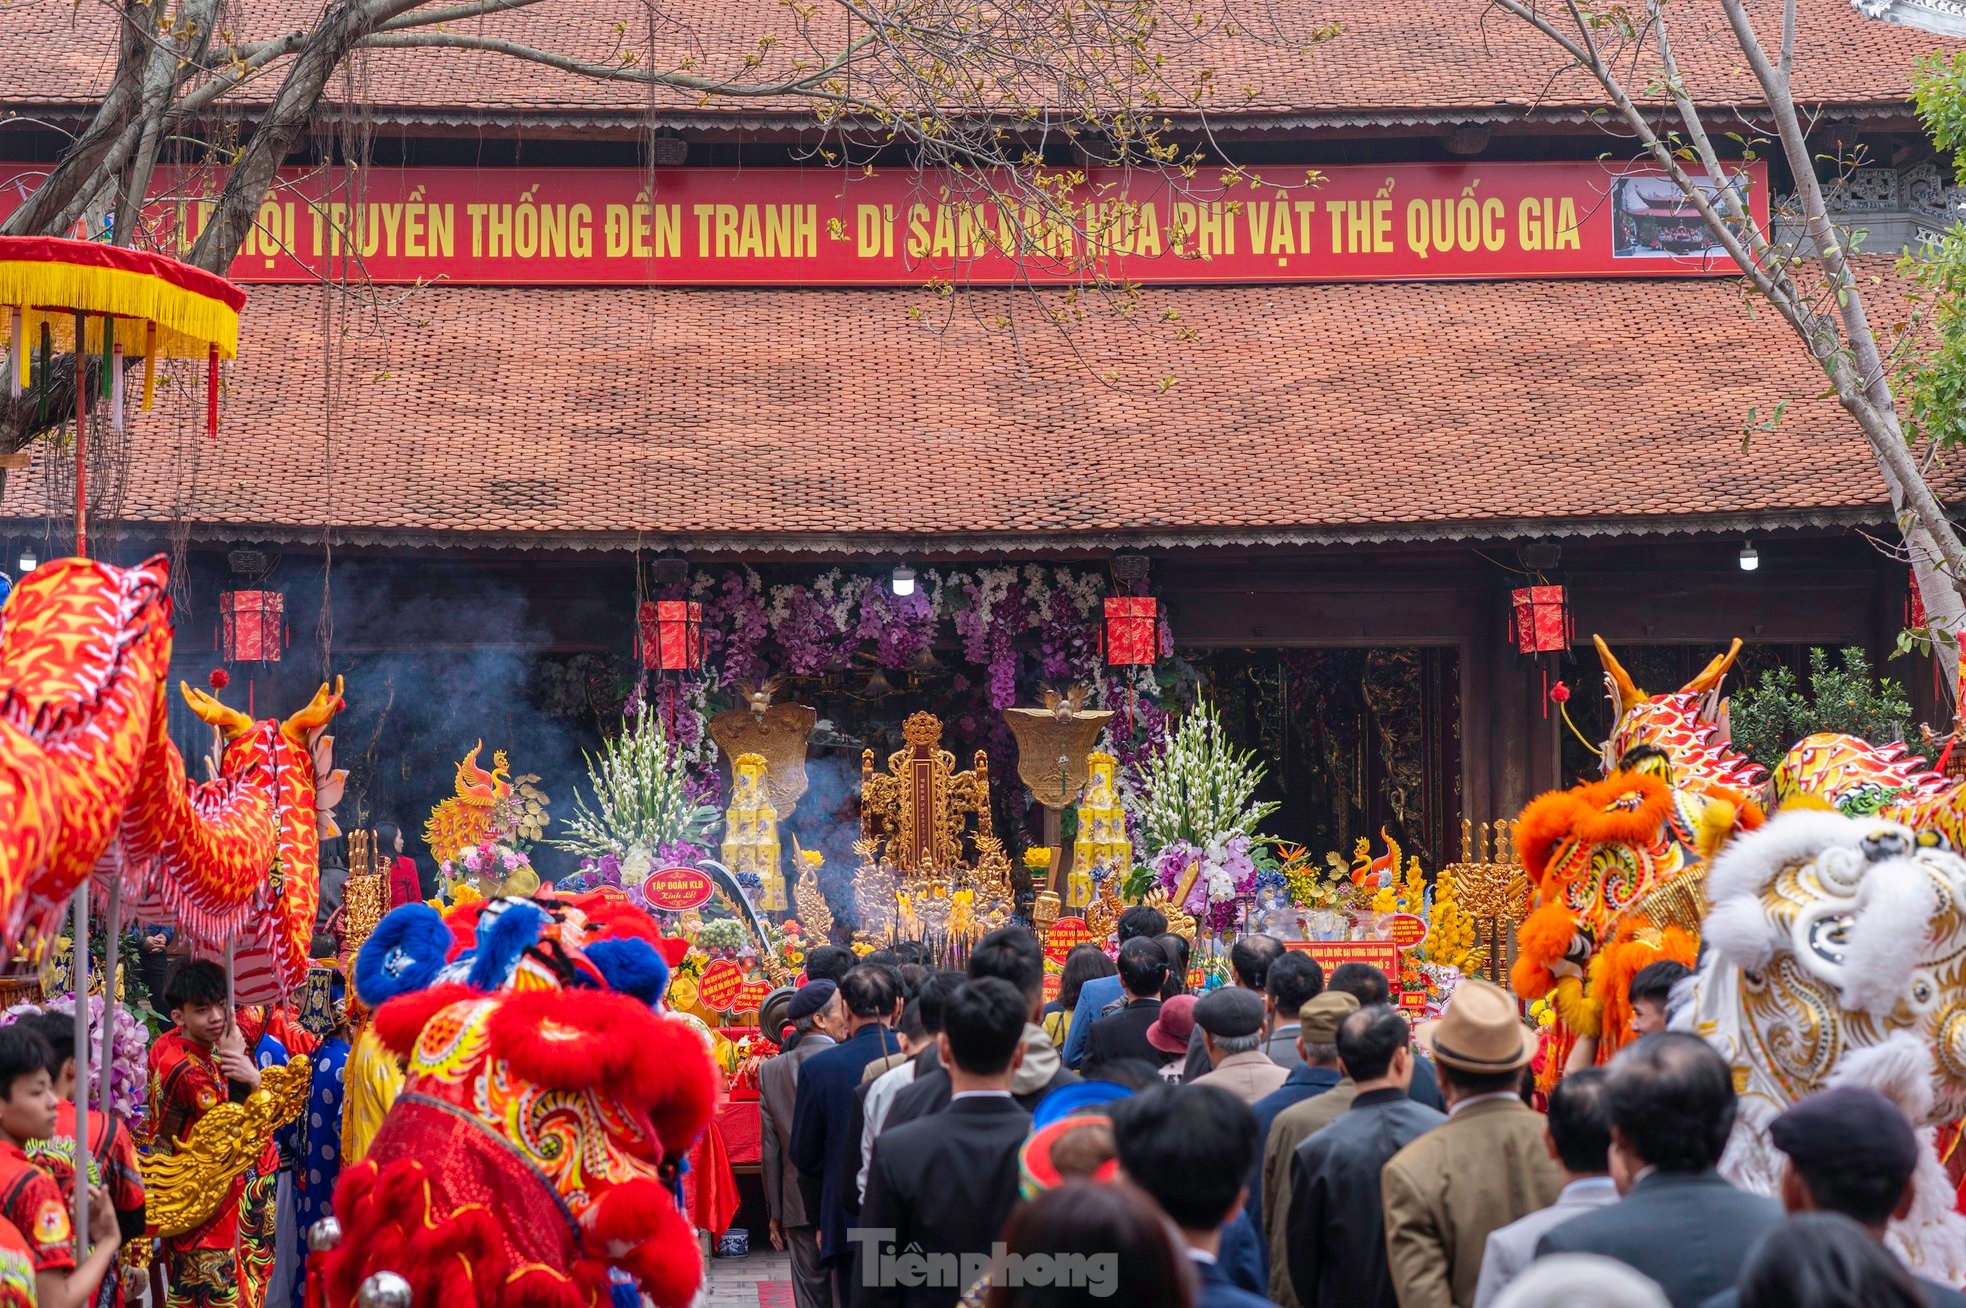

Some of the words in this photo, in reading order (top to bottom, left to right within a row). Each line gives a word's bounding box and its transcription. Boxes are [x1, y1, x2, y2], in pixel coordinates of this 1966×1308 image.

[308, 184, 455, 258] TRUYỀN
[467, 183, 593, 258] THỐNG
[605, 184, 681, 257] ĐỀN
[694, 203, 818, 257] TRANH
[858, 203, 894, 257] DI
[1177, 199, 1235, 255] PHI
[1247, 188, 1313, 266] VẬT
[1325, 176, 1394, 254] THỂ
[1406, 177, 1505, 260] QUỐC
[1518, 196, 1581, 252] GIA
[690, 880, 703, 889] KLB
[1385, 961, 1390, 969] 2
[1419, 995, 1423, 1004] 2
